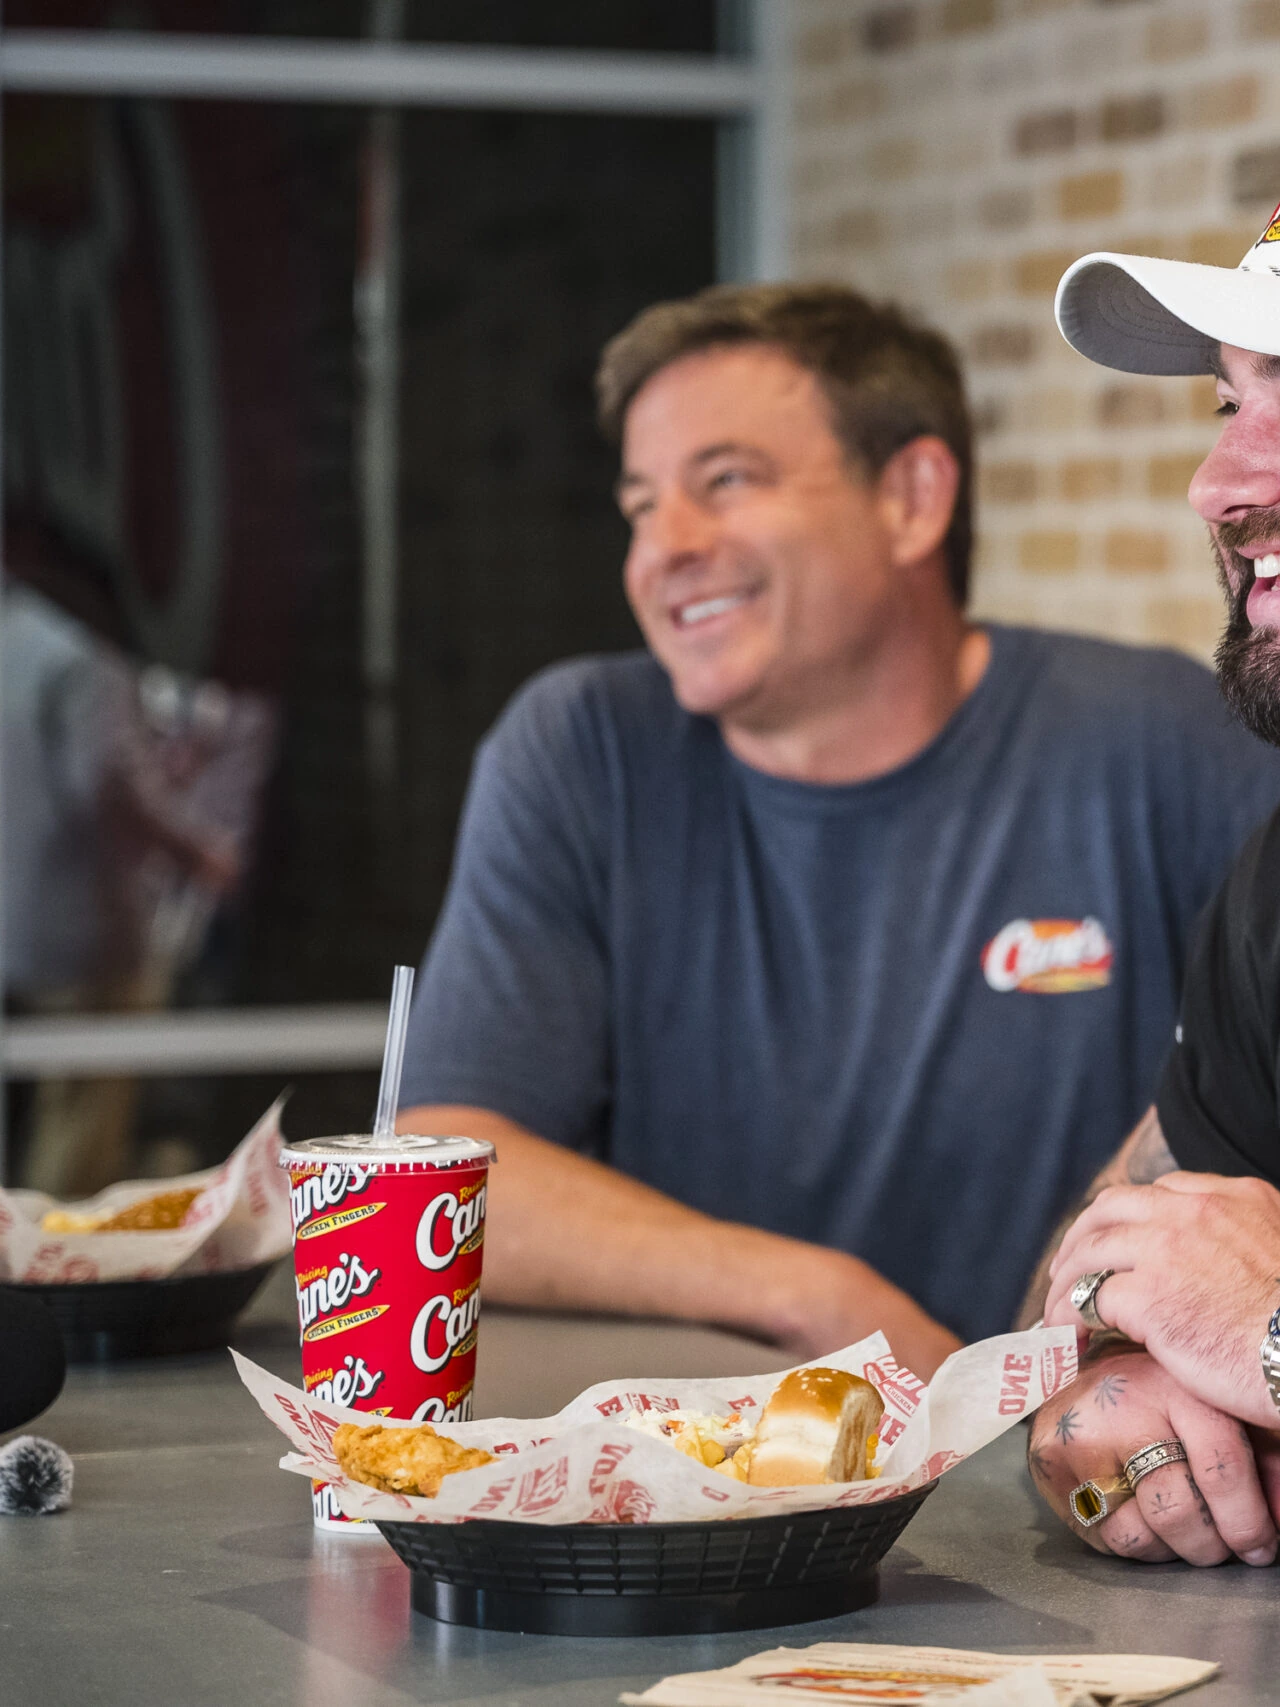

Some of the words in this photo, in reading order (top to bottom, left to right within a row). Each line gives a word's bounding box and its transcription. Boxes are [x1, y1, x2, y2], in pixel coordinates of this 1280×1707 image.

[332, 1205, 376, 1226] FINGERS
[296, 1253, 378, 1345] ane's
[336, 1307, 379, 1329] FINGERS
